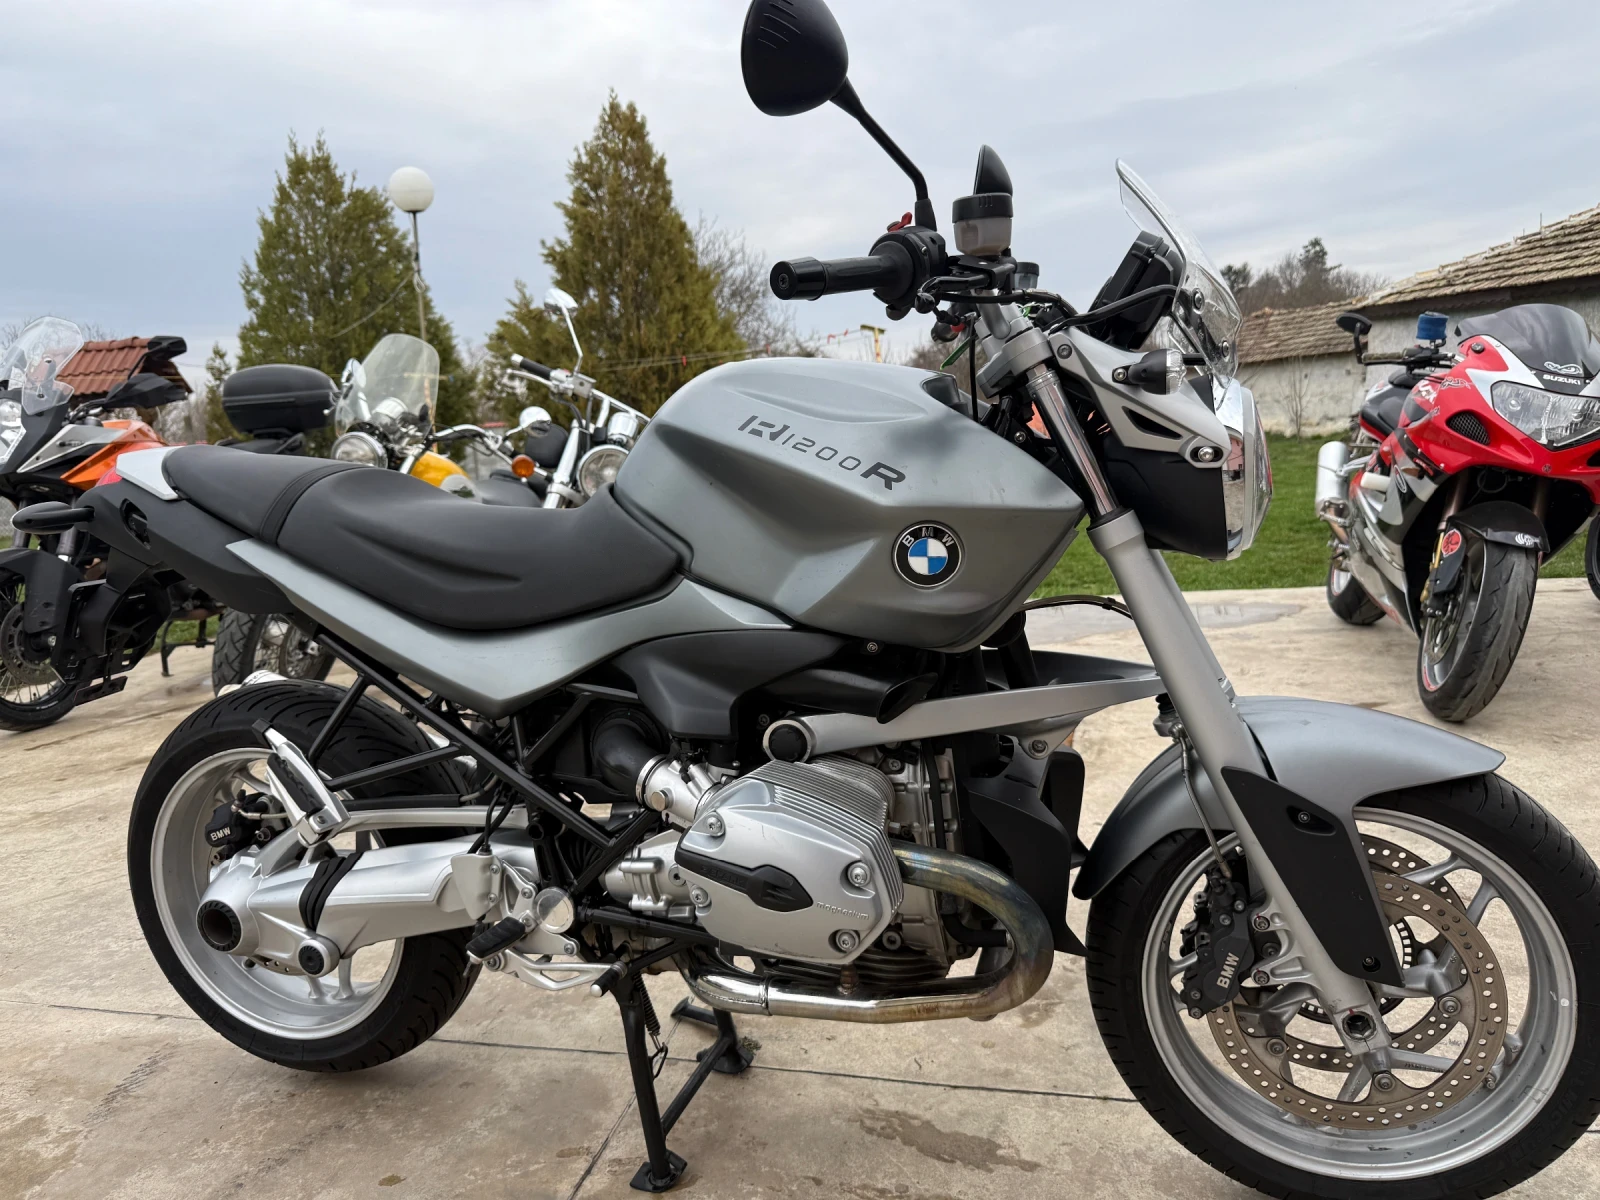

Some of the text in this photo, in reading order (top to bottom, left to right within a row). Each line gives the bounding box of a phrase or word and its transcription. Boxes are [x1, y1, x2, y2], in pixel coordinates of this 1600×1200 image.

[1542, 374, 1581, 385] SUZUKI
[902, 526, 955, 548] BMW
[210, 827, 231, 841] BMW
[1216, 951, 1241, 989] BMW
